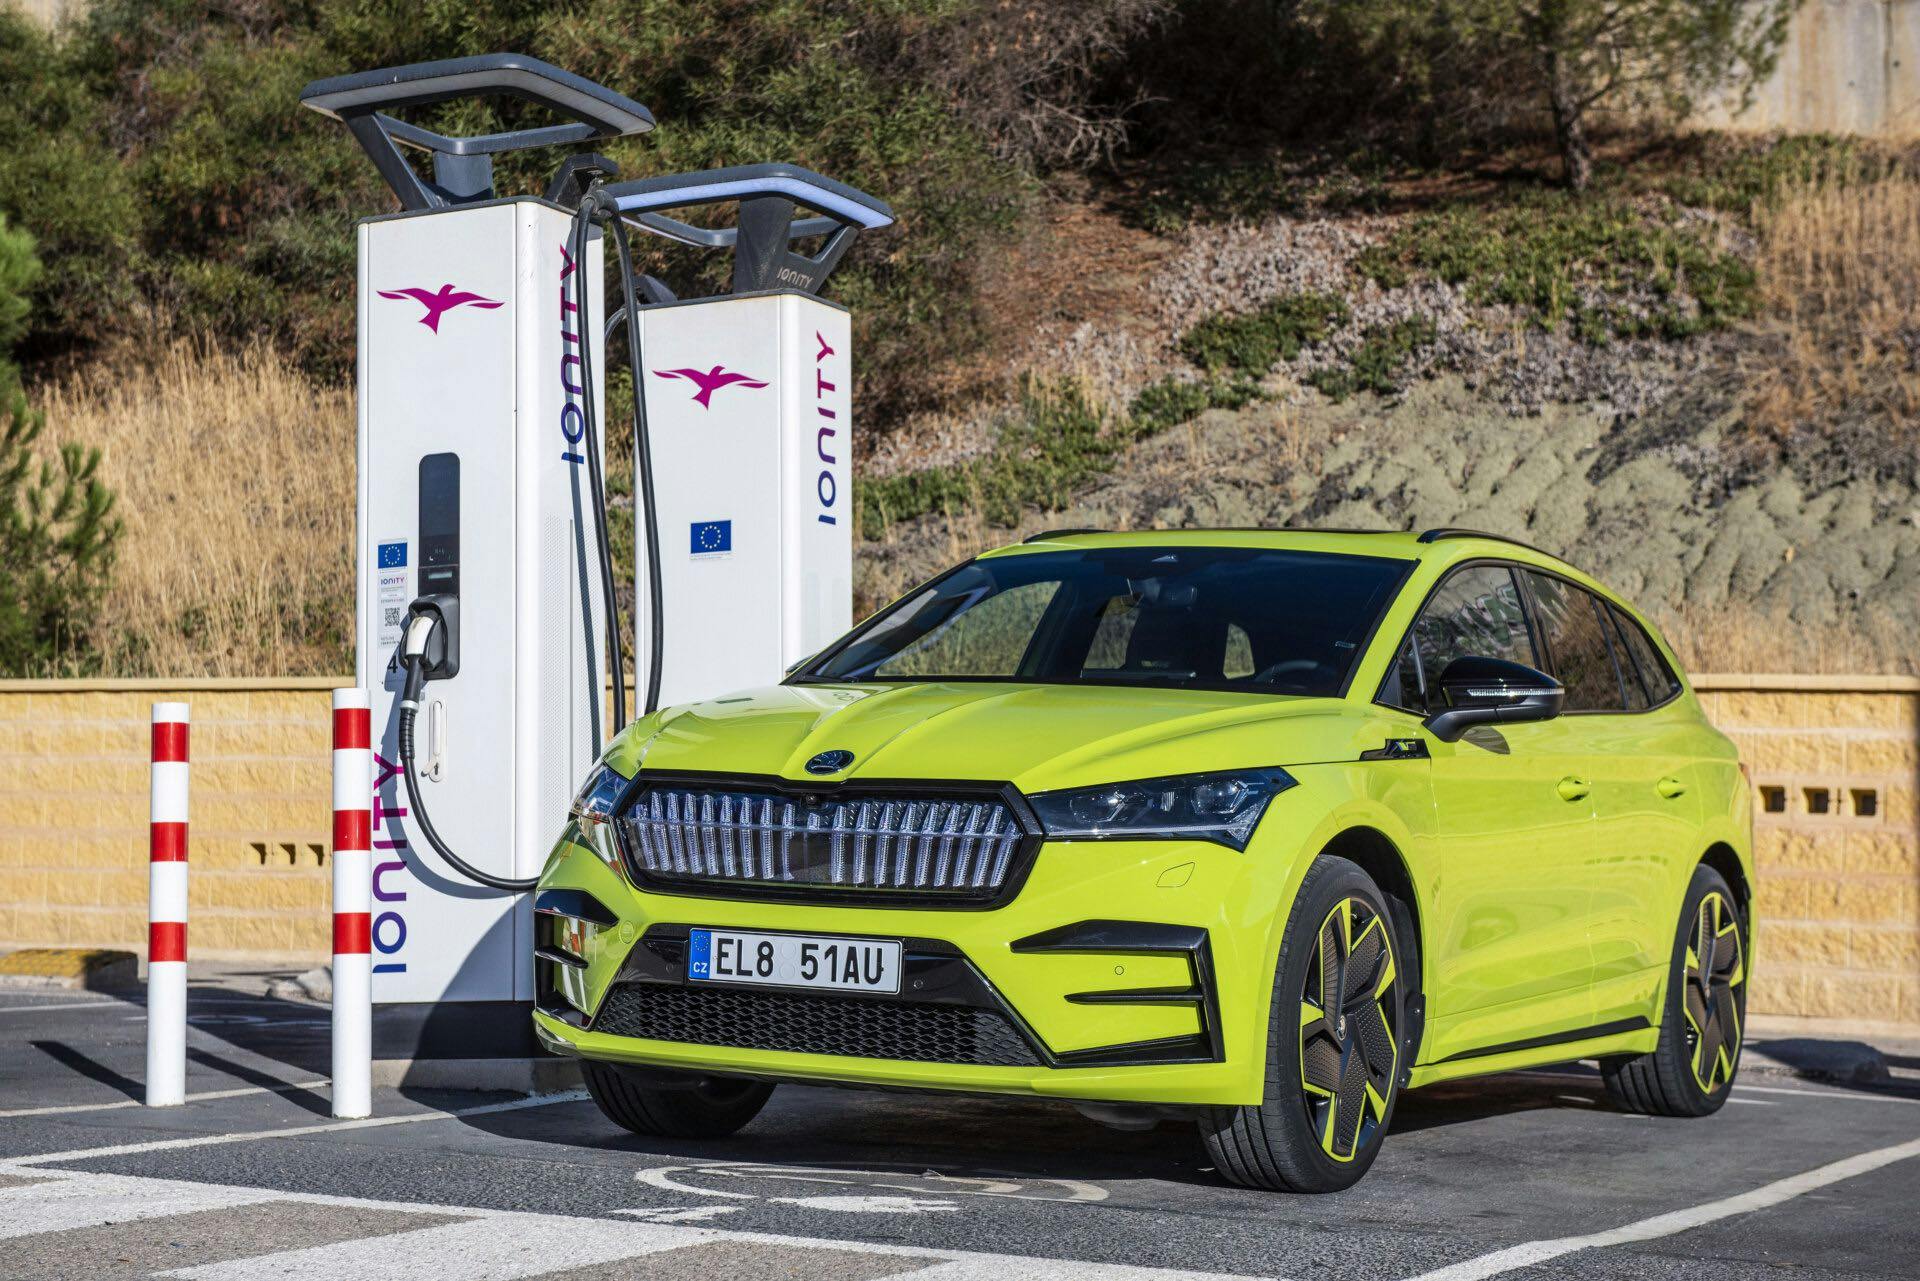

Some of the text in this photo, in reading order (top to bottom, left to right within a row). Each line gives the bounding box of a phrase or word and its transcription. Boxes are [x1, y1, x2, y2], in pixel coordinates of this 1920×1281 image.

[777, 266, 814, 288] IONITY
[560, 242, 584, 464] IONITY
[816, 329, 836, 525] IONITY
[380, 576, 405, 585] IONITY
[387, 655, 398, 673] 4
[372, 752, 408, 974] IONITY
[693, 961, 708, 973] CZ
[716, 937, 884, 985] EL8 51AU
